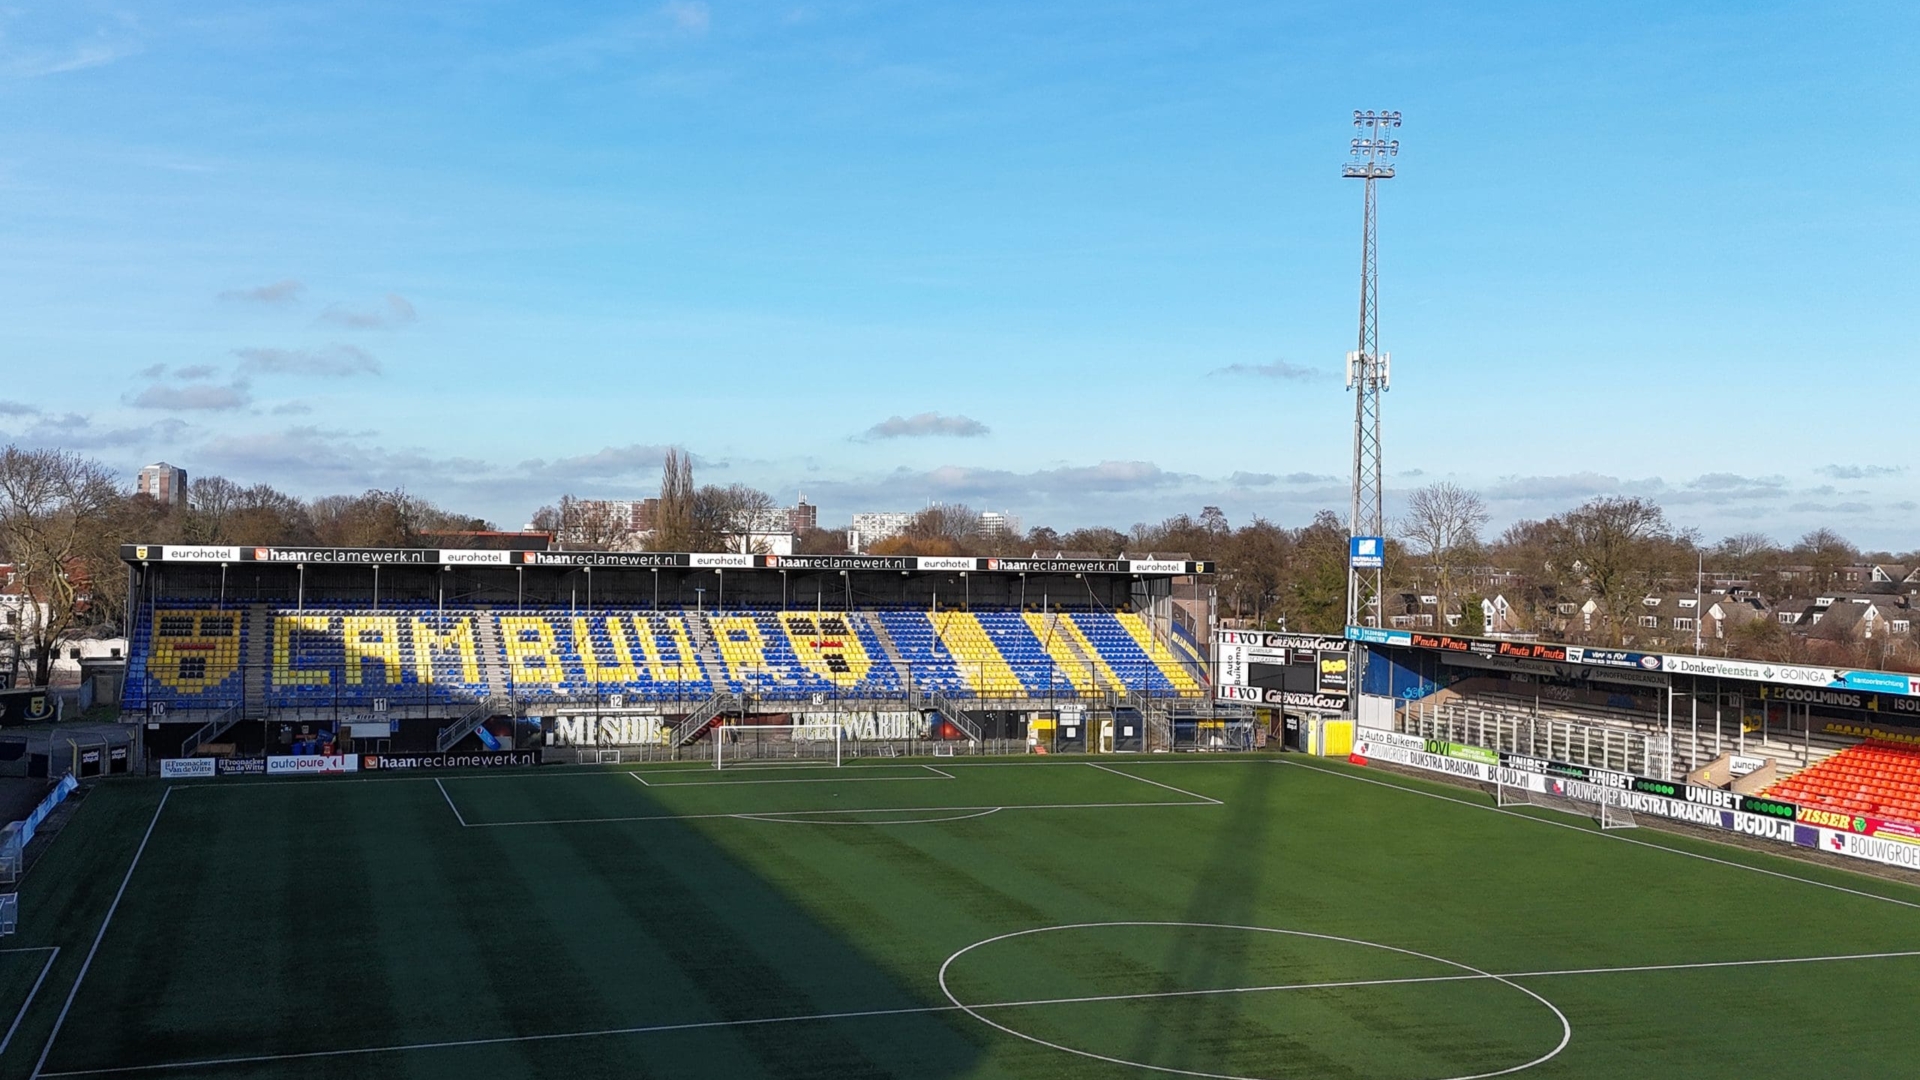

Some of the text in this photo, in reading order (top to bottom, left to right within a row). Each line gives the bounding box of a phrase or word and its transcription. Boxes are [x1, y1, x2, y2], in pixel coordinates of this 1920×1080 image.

[171, 548, 231, 559] eurohotel
[270, 549, 425, 562] haanreclamewerk.nl
[448, 553, 502, 562] eurohotel
[537, 552, 677, 565] haanreclamewerk.nl
[697, 556, 746, 566] eurohotel
[778, 556, 906, 569] haanreclamewerk.nl
[924, 559, 970, 568] eurohotel
[999, 559, 1119, 572] haanreclamewerk.nl
[1136, 563, 1180, 572] eurohotel
[1221, 632, 1258, 645] LEVO
[1234, 646, 1242, 685] Buikema
[1596, 671, 1666, 685] SPINOFFNEDERLAND.NL
[1780, 668, 1827, 683] GOINGA
[814, 694, 823, 704] 13
[1221, 687, 1257, 700] LEVO
[1785, 688, 1860, 707] COOLMINDS
[375, 699, 386, 711] 11
[611, 696, 622, 707] 12
[154, 703, 165, 714] 10
[1365, 731, 1384, 742] Auto
[1387, 733, 1424, 750] Buikema
[270, 758, 324, 770] autojoure
[379, 752, 536, 769] haanreclamewerk.nl
[1370, 744, 1408, 763] BOUWGROEP
[1445, 758, 1480, 777] DRAISMA
[1508, 755, 1549, 774] UNIBET
[1589, 769, 1635, 790] UNIBET
[1686, 787, 1743, 809] UNIBET
[1566, 781, 1618, 805] BOUWGROEP
[1670, 801, 1723, 827] DRAISMA
[1734, 811, 1794, 841] BGDD.nl
[1798, 807, 1850, 829] VISSER
[1851, 835, 1920, 868] BOUWGROE
